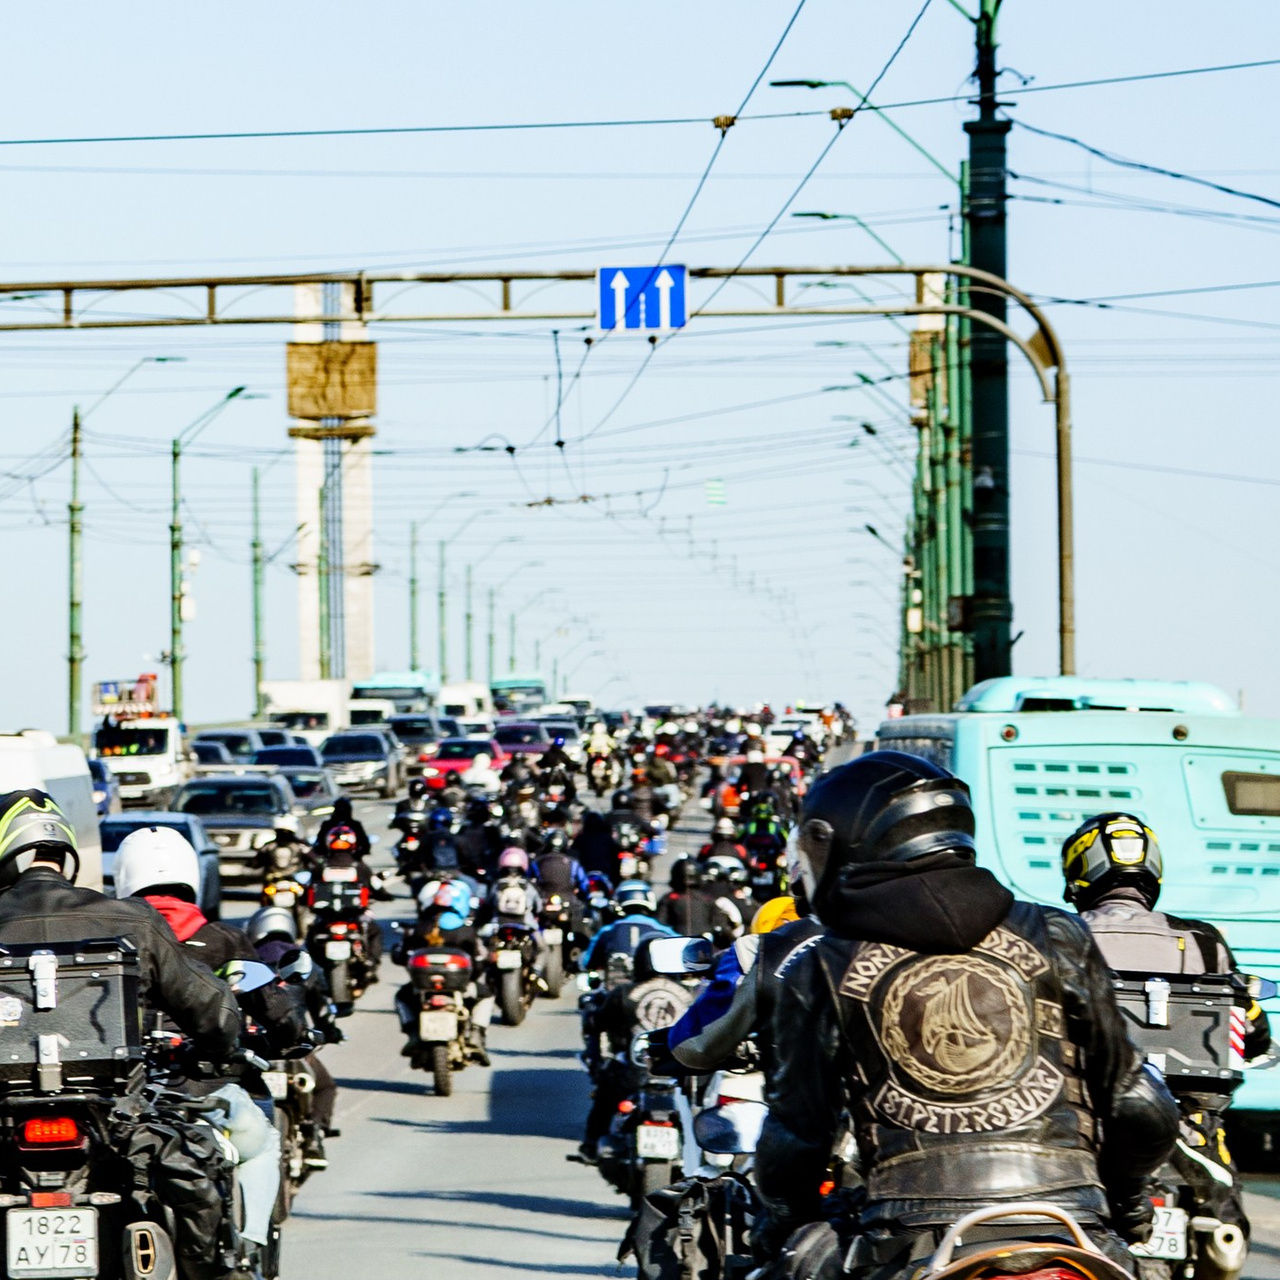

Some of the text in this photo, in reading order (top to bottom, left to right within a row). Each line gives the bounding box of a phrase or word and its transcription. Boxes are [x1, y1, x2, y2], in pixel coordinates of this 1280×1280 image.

[844, 942, 907, 993] NOR
[22, 1215, 81, 1235] 1822
[59, 1244, 87, 1264] 78
[1154, 1236, 1179, 1253] 78
